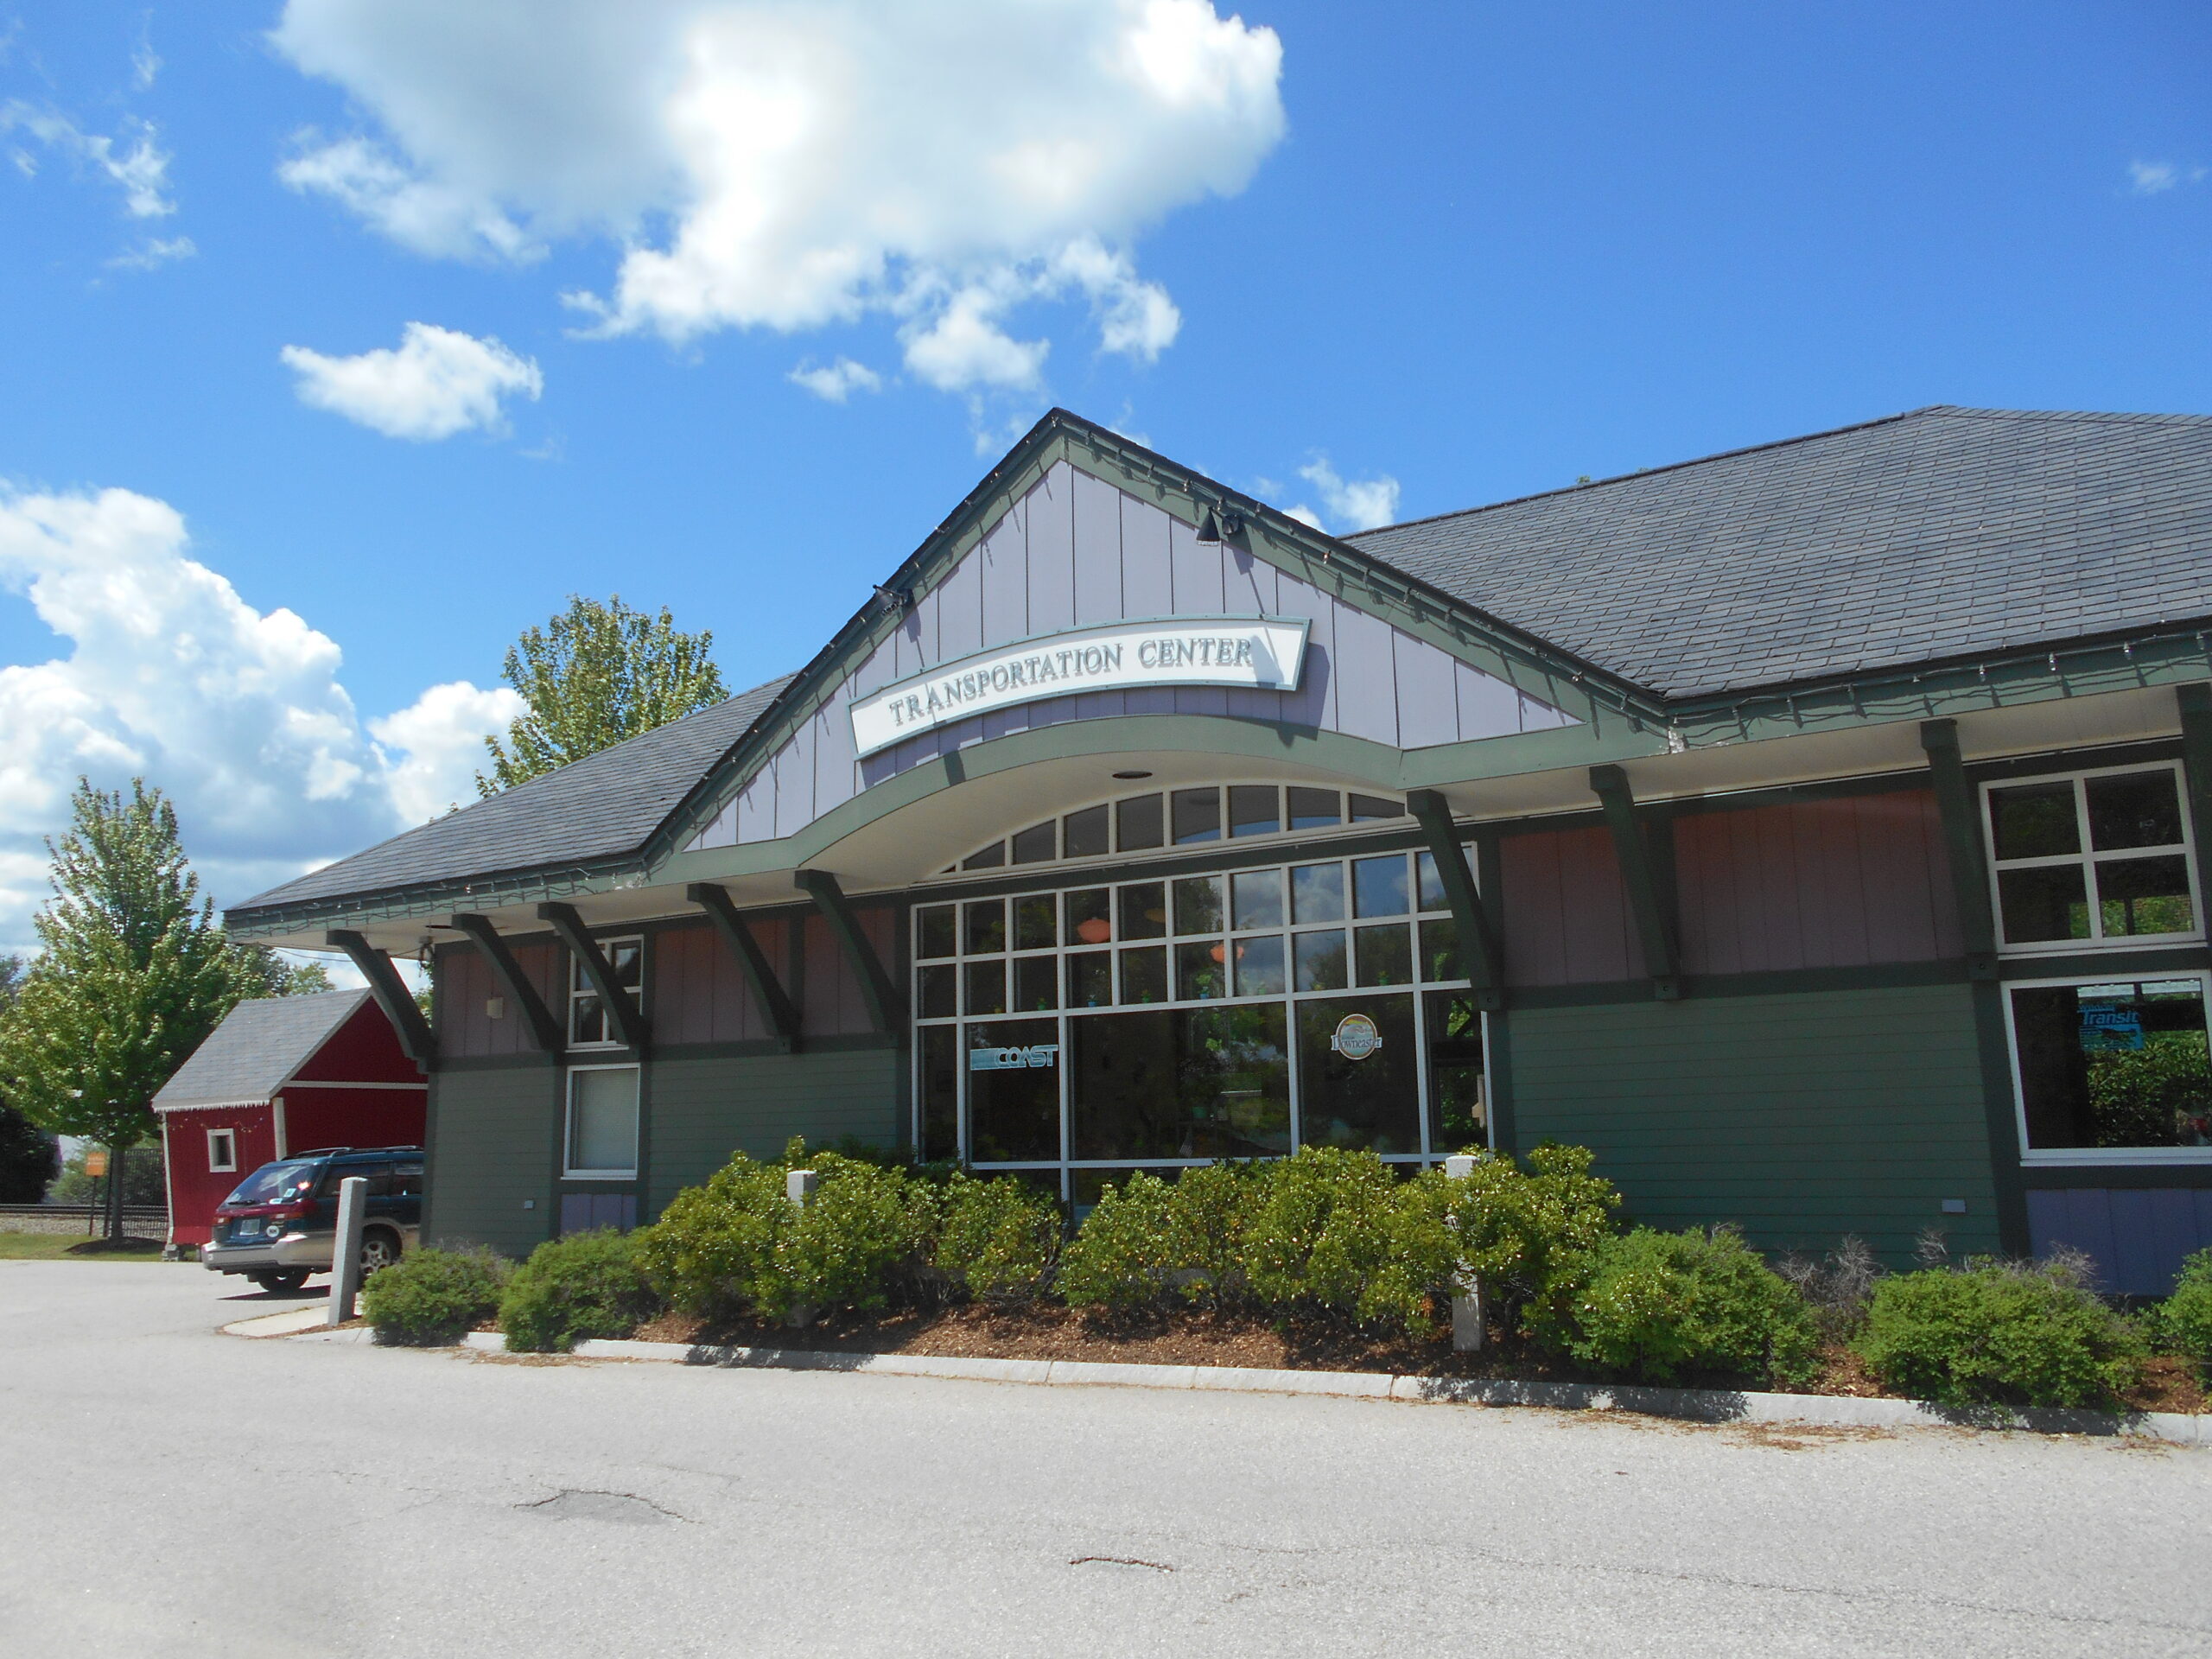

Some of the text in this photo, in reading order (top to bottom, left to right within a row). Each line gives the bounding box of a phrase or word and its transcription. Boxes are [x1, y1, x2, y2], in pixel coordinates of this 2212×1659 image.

[889, 638, 1253, 727] TRANSPORTATION CENTER
[2078, 1009, 2139, 1026] Transit
[995, 1045, 1058, 1068] COAST
